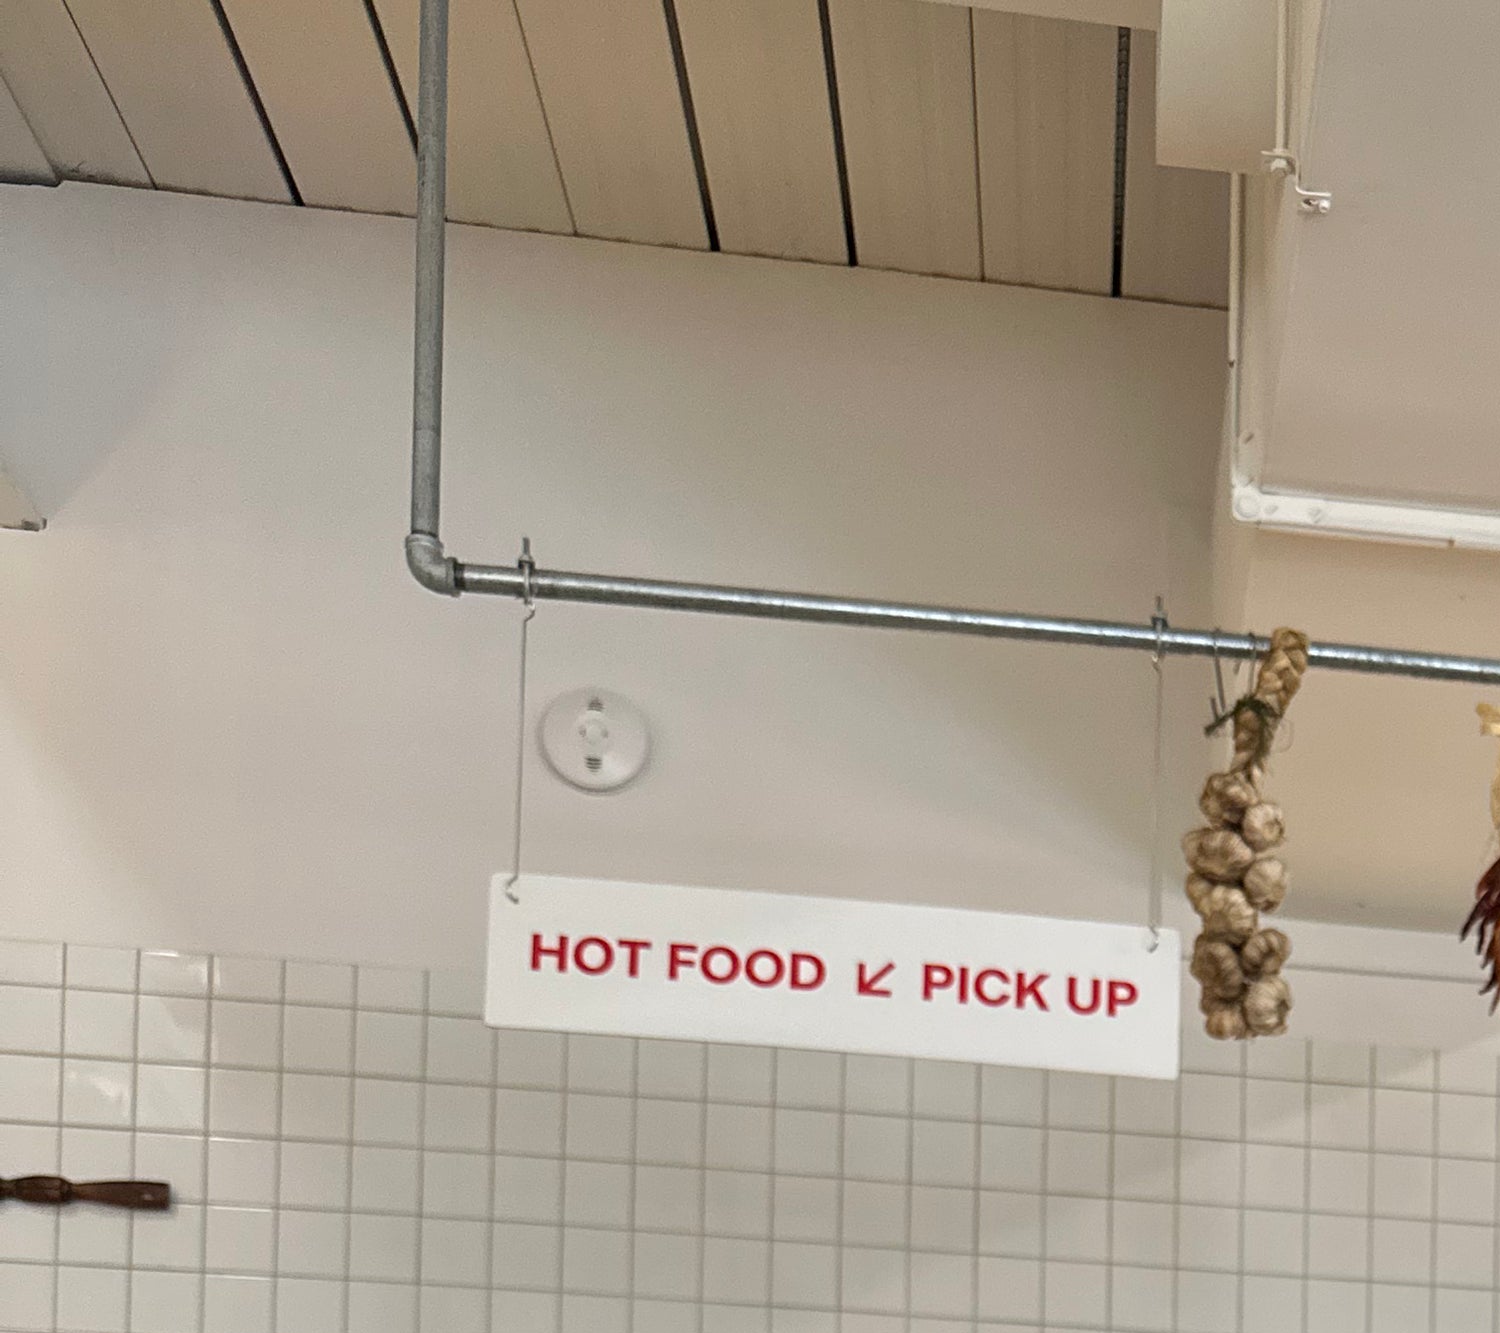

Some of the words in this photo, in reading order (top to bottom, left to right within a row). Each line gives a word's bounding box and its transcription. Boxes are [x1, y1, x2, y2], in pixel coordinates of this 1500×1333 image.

[530, 932, 652, 979] HOT
[667, 941, 828, 992] FOOD
[921, 961, 1051, 1013] PICK
[1065, 975, 1140, 1019] UP
